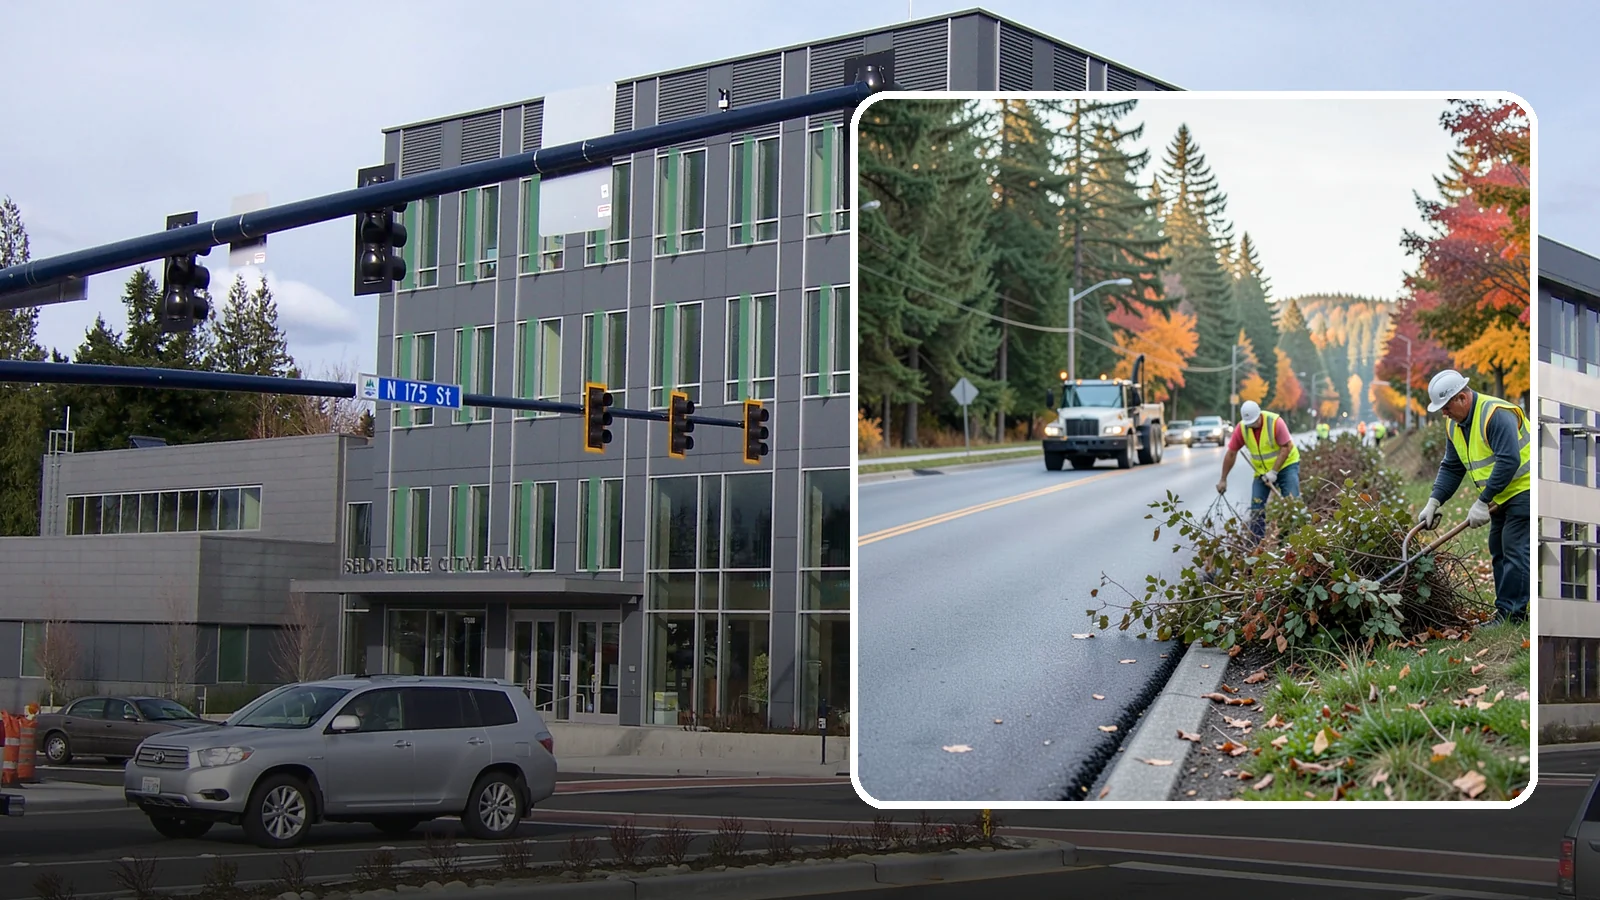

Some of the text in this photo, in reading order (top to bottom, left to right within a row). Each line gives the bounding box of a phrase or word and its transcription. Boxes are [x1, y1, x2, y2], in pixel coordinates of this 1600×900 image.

[387, 380, 452, 406] N 175 St
[344, 555, 525, 574] SHORELINE CITY HALL
